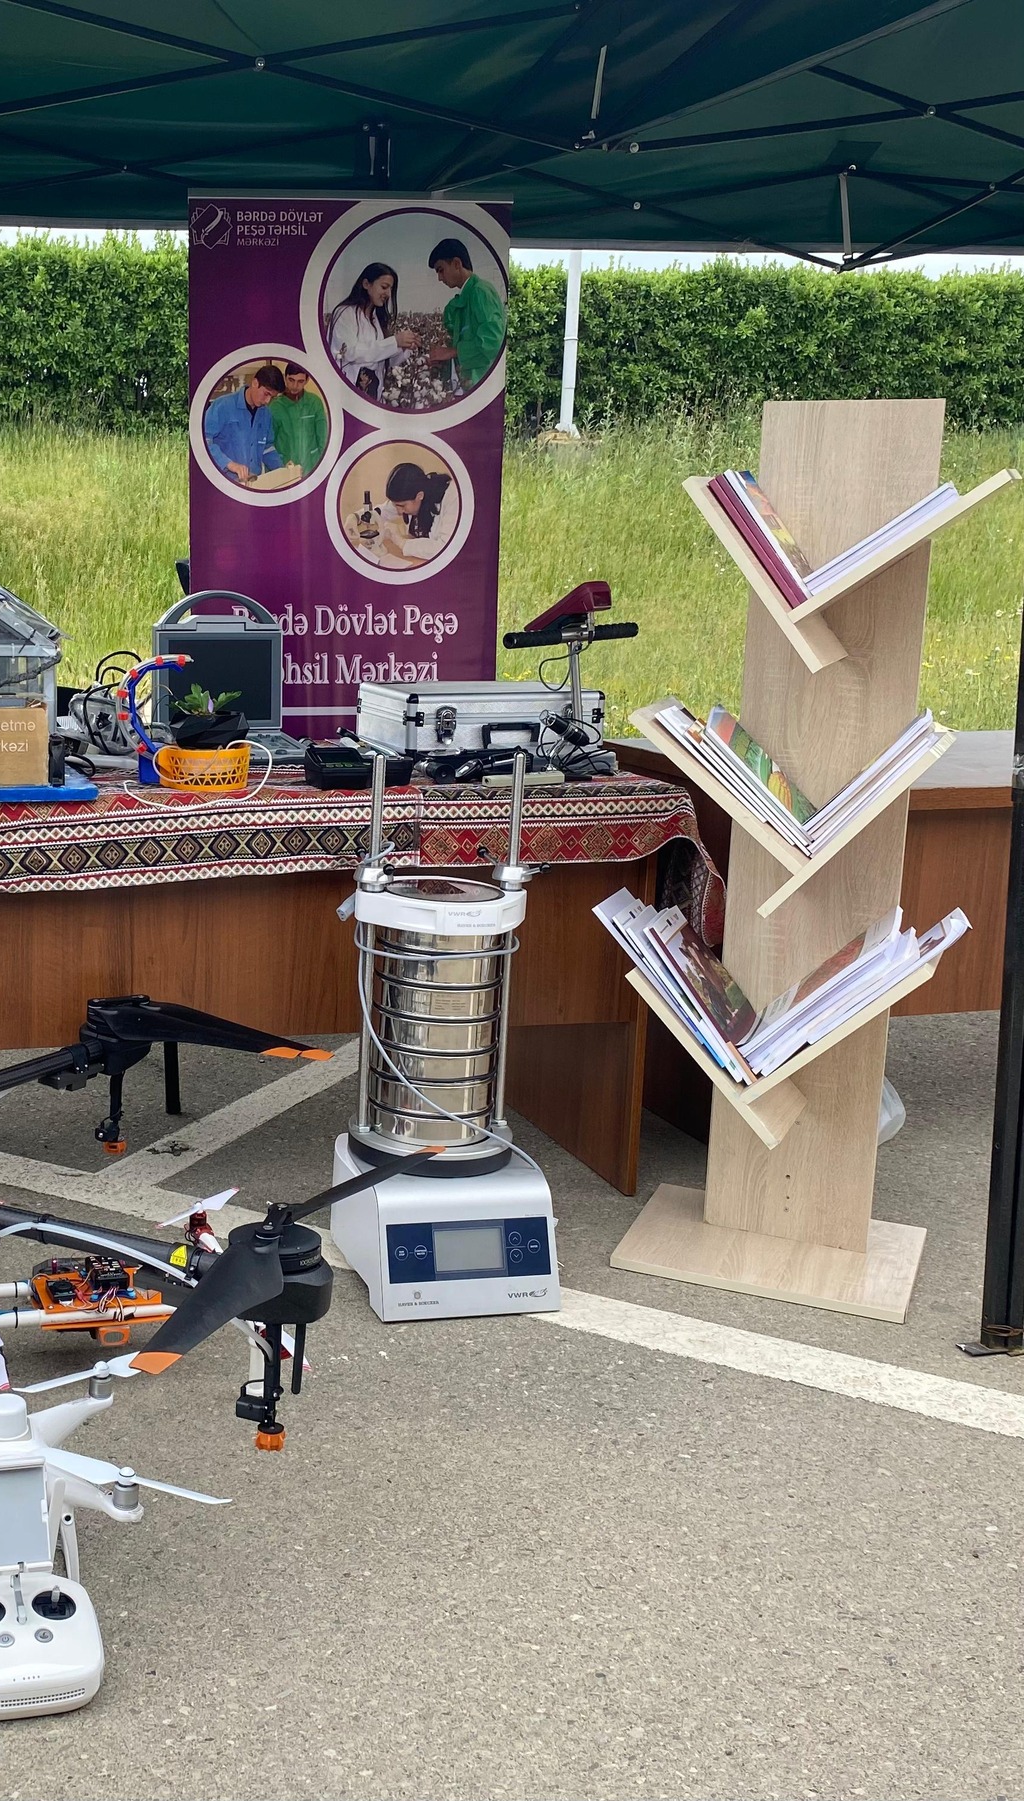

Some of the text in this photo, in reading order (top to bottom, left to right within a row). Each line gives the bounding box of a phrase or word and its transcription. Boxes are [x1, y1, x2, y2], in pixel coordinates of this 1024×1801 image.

[236, 208, 324, 223] BƏRDƏ DÖVLƏT
[236, 222, 308, 237] PEŞƏ TƏHSİL
[236, 236, 280, 246] MƏRKƏZİ
[314, 603, 398, 636] Dövlət
[403, 604, 459, 644] Peşə
[334, 651, 439, 685] Mərkəzi
